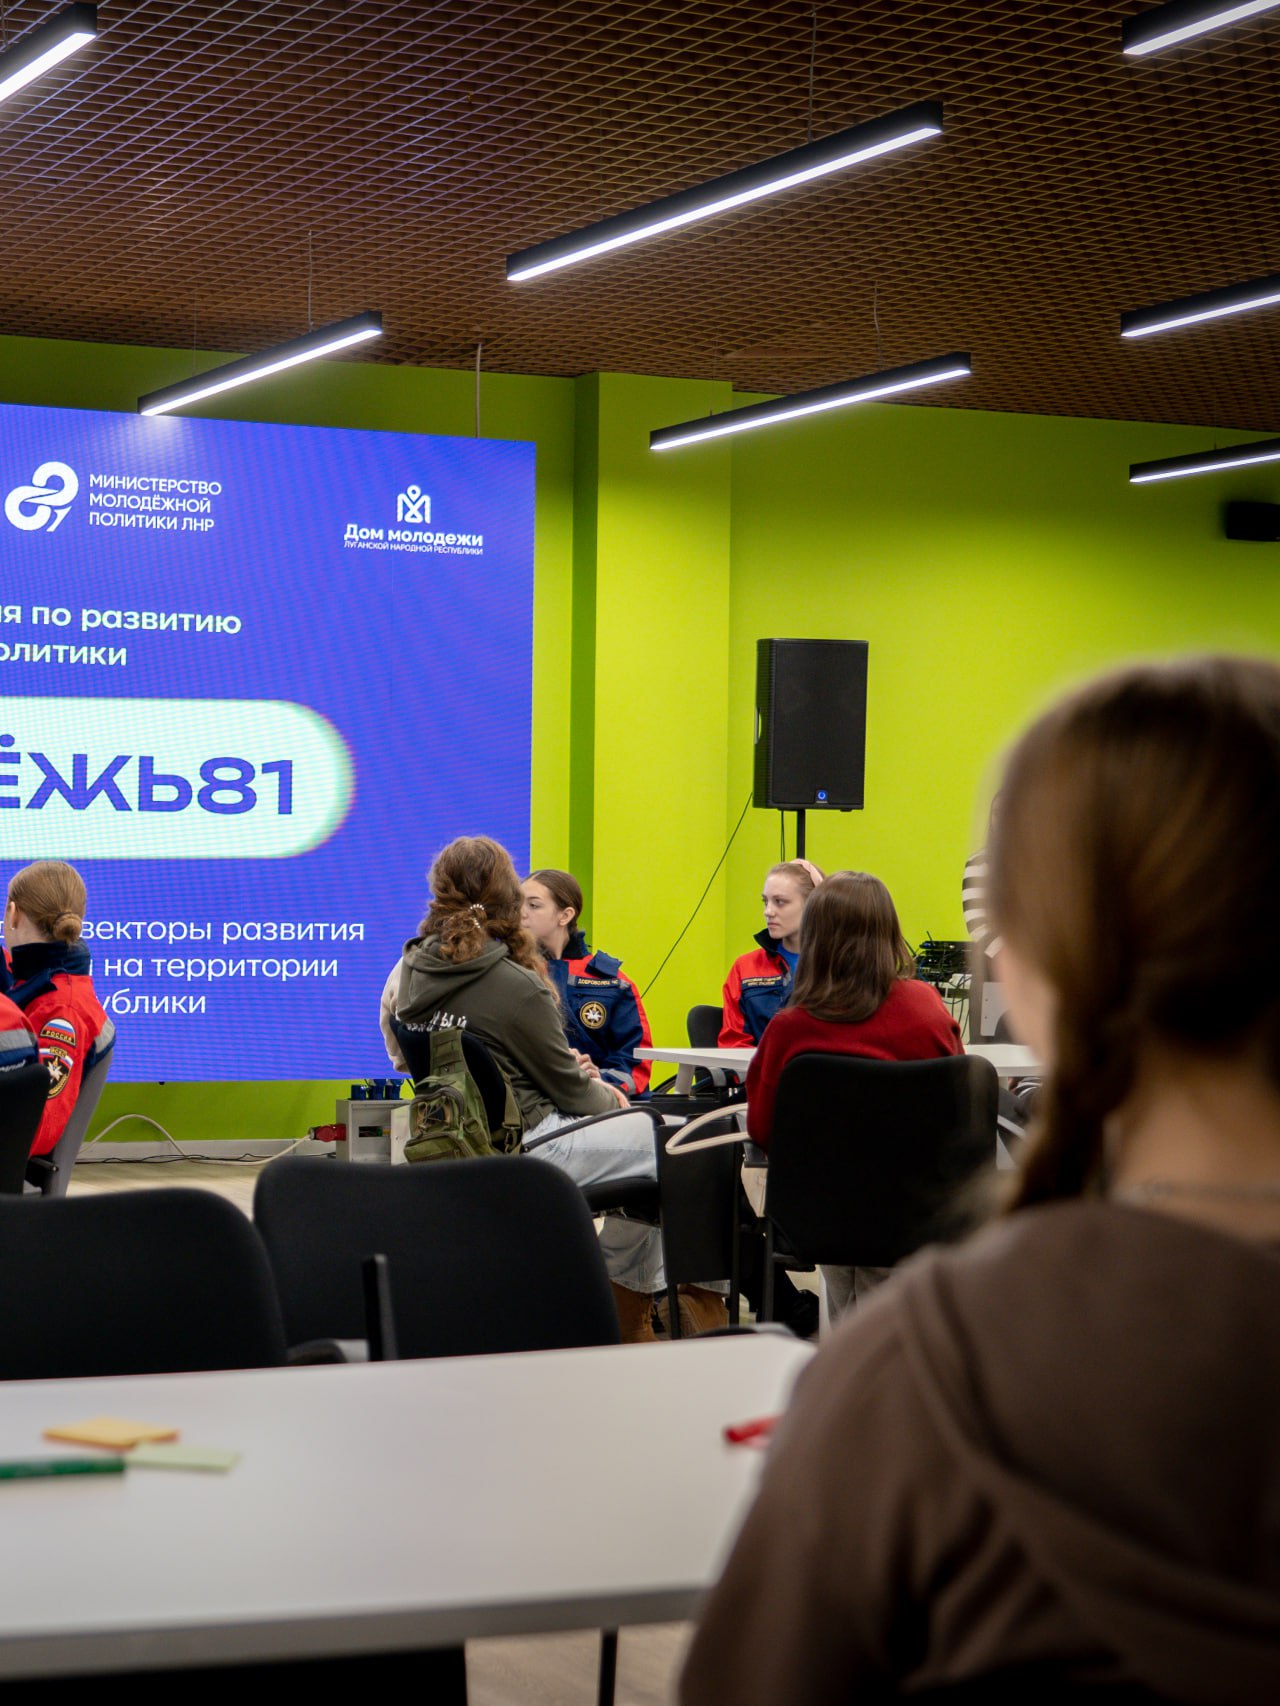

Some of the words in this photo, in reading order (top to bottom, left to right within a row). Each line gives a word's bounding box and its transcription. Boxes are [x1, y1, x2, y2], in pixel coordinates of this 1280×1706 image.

[89, 473, 222, 496] МИНИСТЕРСТВО
[89, 492, 211, 513] МОЛОДЁЖНОЙ
[89, 512, 178, 530] ПОЛИТИКИ
[181, 517, 215, 532] ЛНР
[344, 523, 384, 541] Дом
[388, 529, 483, 547] молодежи
[344, 540, 389, 551] ЛУГАНСКОЙ
[390, 543, 433, 554] НАРОДНОЙ
[433, 545, 483, 556] РЕСПУБЛИКИ
[32, 606, 72, 627] по
[81, 608, 242, 635] развитию
[80, 920, 211, 945] векторы
[222, 922, 364, 945] развития
[104, 958, 143, 977] на
[150, 958, 338, 982] территории
[97, 988, 206, 1014] ублики
[45, 1030, 72, 1043] РОССИЯ
